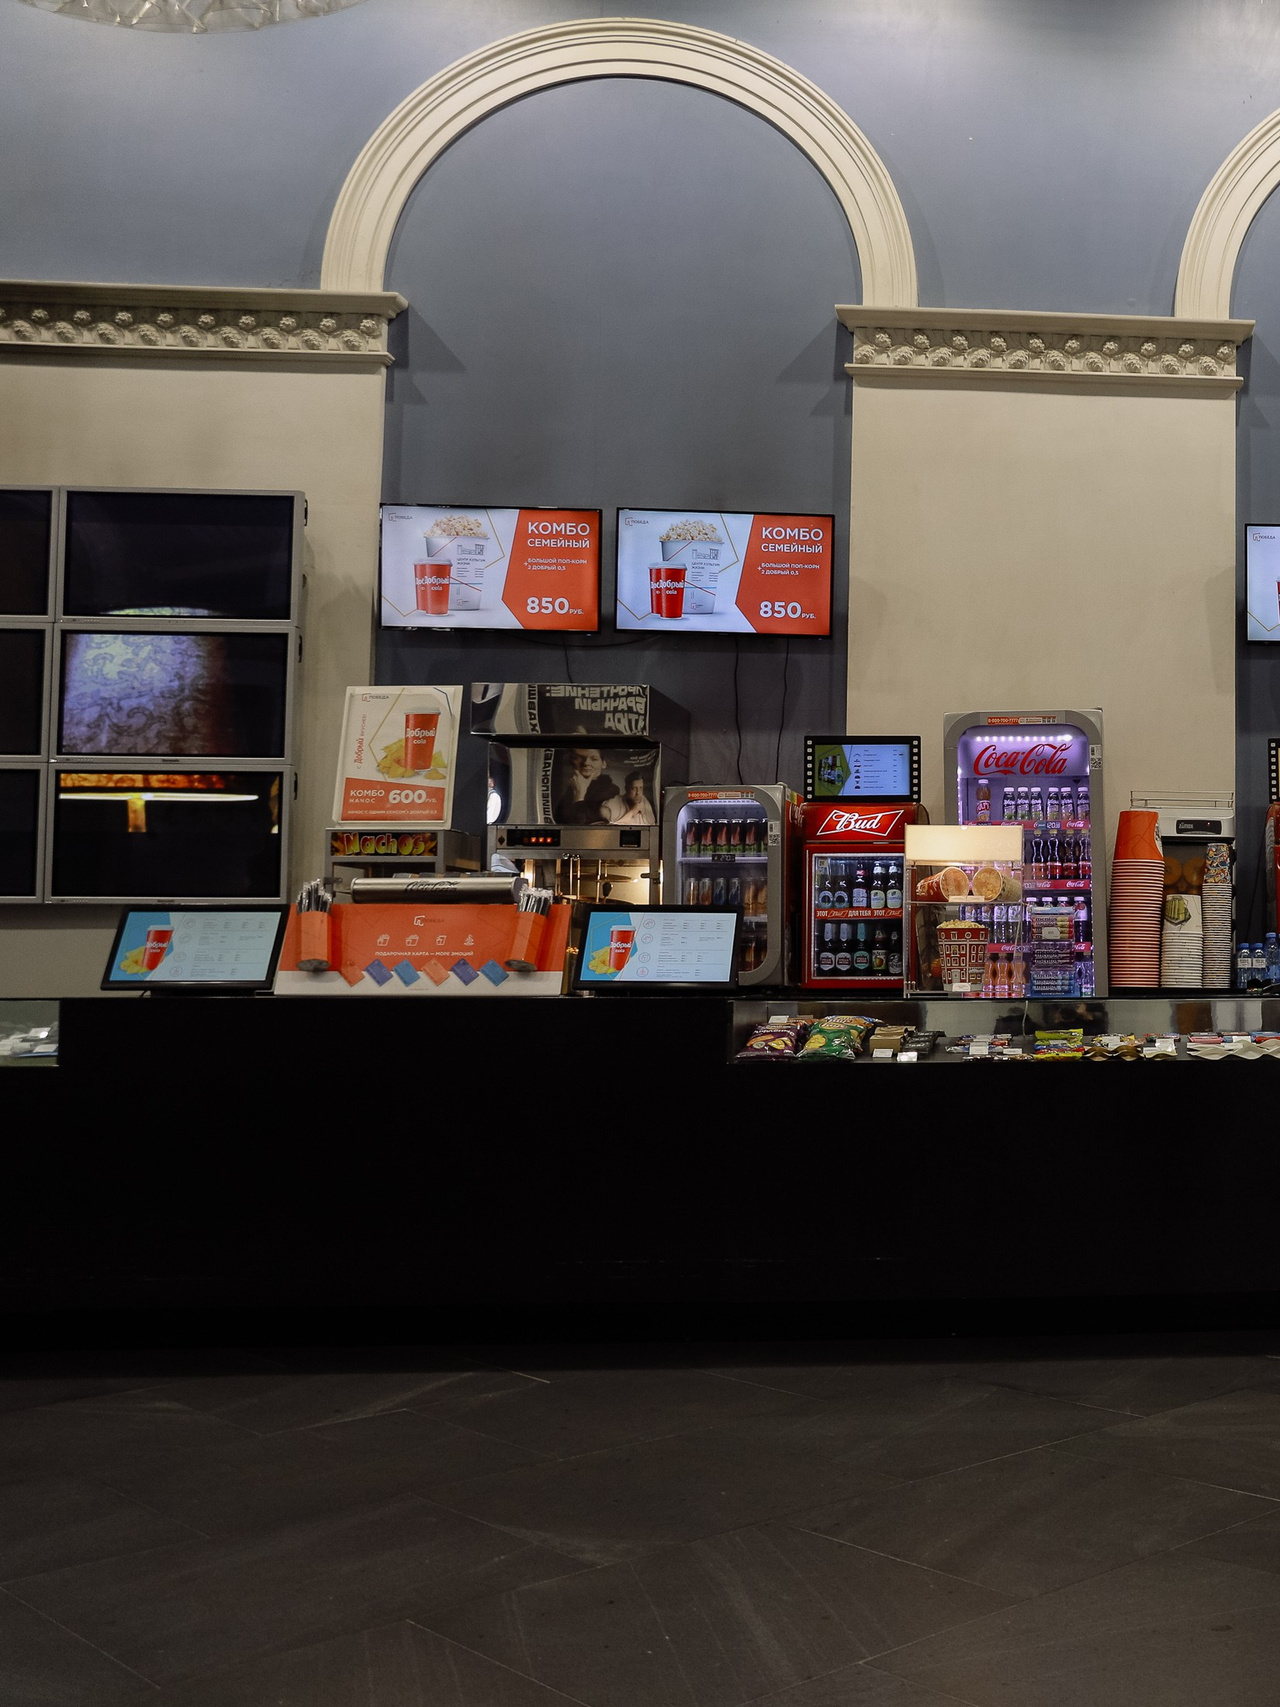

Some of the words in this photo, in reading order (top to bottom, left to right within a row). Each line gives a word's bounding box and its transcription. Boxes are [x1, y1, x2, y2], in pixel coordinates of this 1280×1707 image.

[527, 521, 591, 536] КОМБО
[761, 526, 824, 541] КОМБО
[527, 537, 591, 548] СЕМЕЙНЫЙ
[761, 543, 823, 553] СЕМЕЙНЫЙ
[526, 597, 570, 615] 850
[759, 600, 802, 619] 850
[405, 728, 436, 738] Добрый
[353, 738, 364, 764] Добрый
[973, 743, 1074, 776] Coca-Cola
[349, 789, 385, 797] КОМБО
[388, 789, 427, 804] 600
[832, 812, 883, 831] Bud
